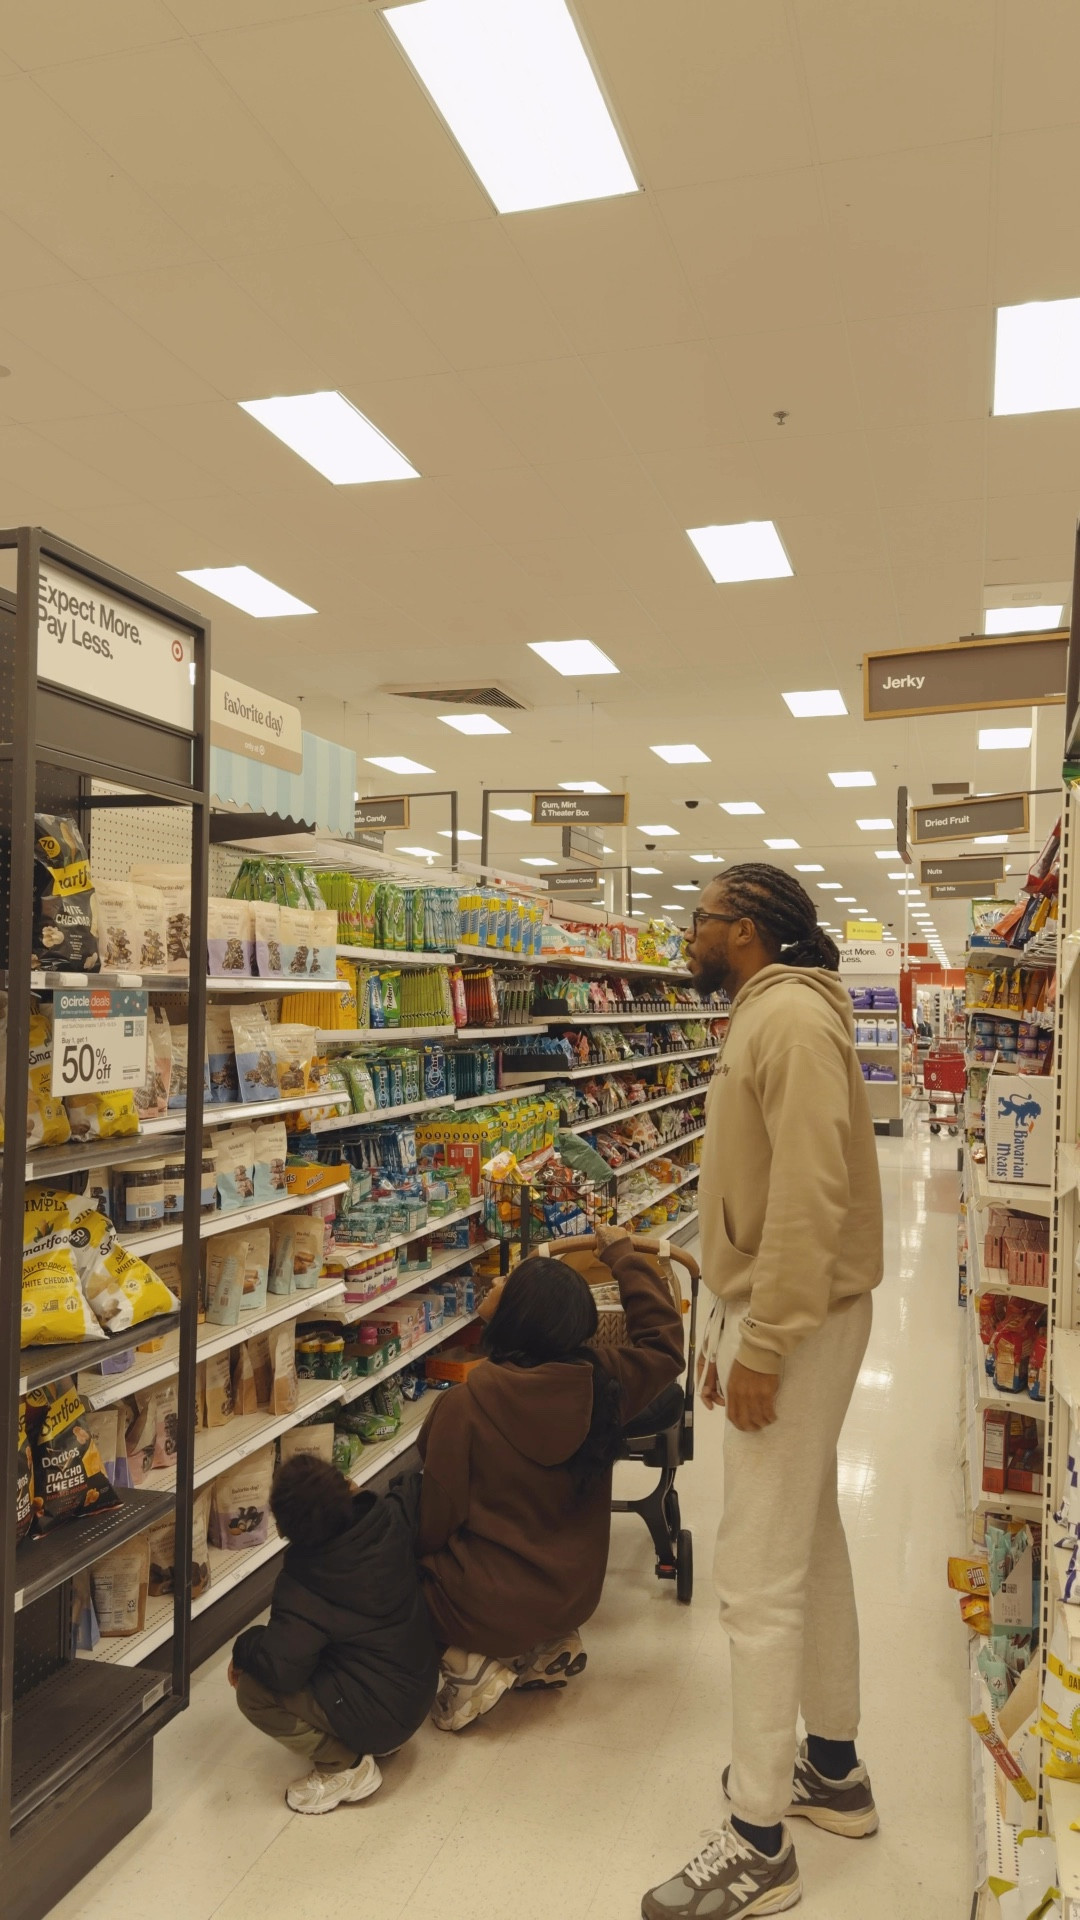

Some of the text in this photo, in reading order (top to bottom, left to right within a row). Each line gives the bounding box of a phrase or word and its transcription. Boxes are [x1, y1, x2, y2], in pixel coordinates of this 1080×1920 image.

[39, 574, 142, 645] Expect More.
[39, 603, 114, 660] Pay Less.
[882, 675, 925, 690] Jerky
[224, 691, 284, 737] favorite day
[541, 801, 577, 809] Gum, Mint
[366, 815, 386, 823] Candy
[541, 809, 547, 817] &
[548, 809, 575, 817] Theater
[925, 815, 970, 828] Dried Fruit
[41, 840, 55, 850] 70
[56, 914, 91, 927] CHEDDAR
[69, 995, 110, 1007] circle deals
[386, 982, 394, 1011] Trident
[96, 1064, 111, 1080] off
[996, 1143, 1011, 1177] Meats
[1013, 1130, 1029, 1178] Bavarian
[72, 1229, 85, 1243] 50
[115, 1259, 136, 1275] WHITE
[44, 1276, 74, 1285] CHEDDAR
[28, 1389, 42, 1401] 70
[42, 1446, 80, 1469] Doritos
[47, 1464, 82, 1484] NACHO
[46, 1474, 85, 1495] CHEESE
